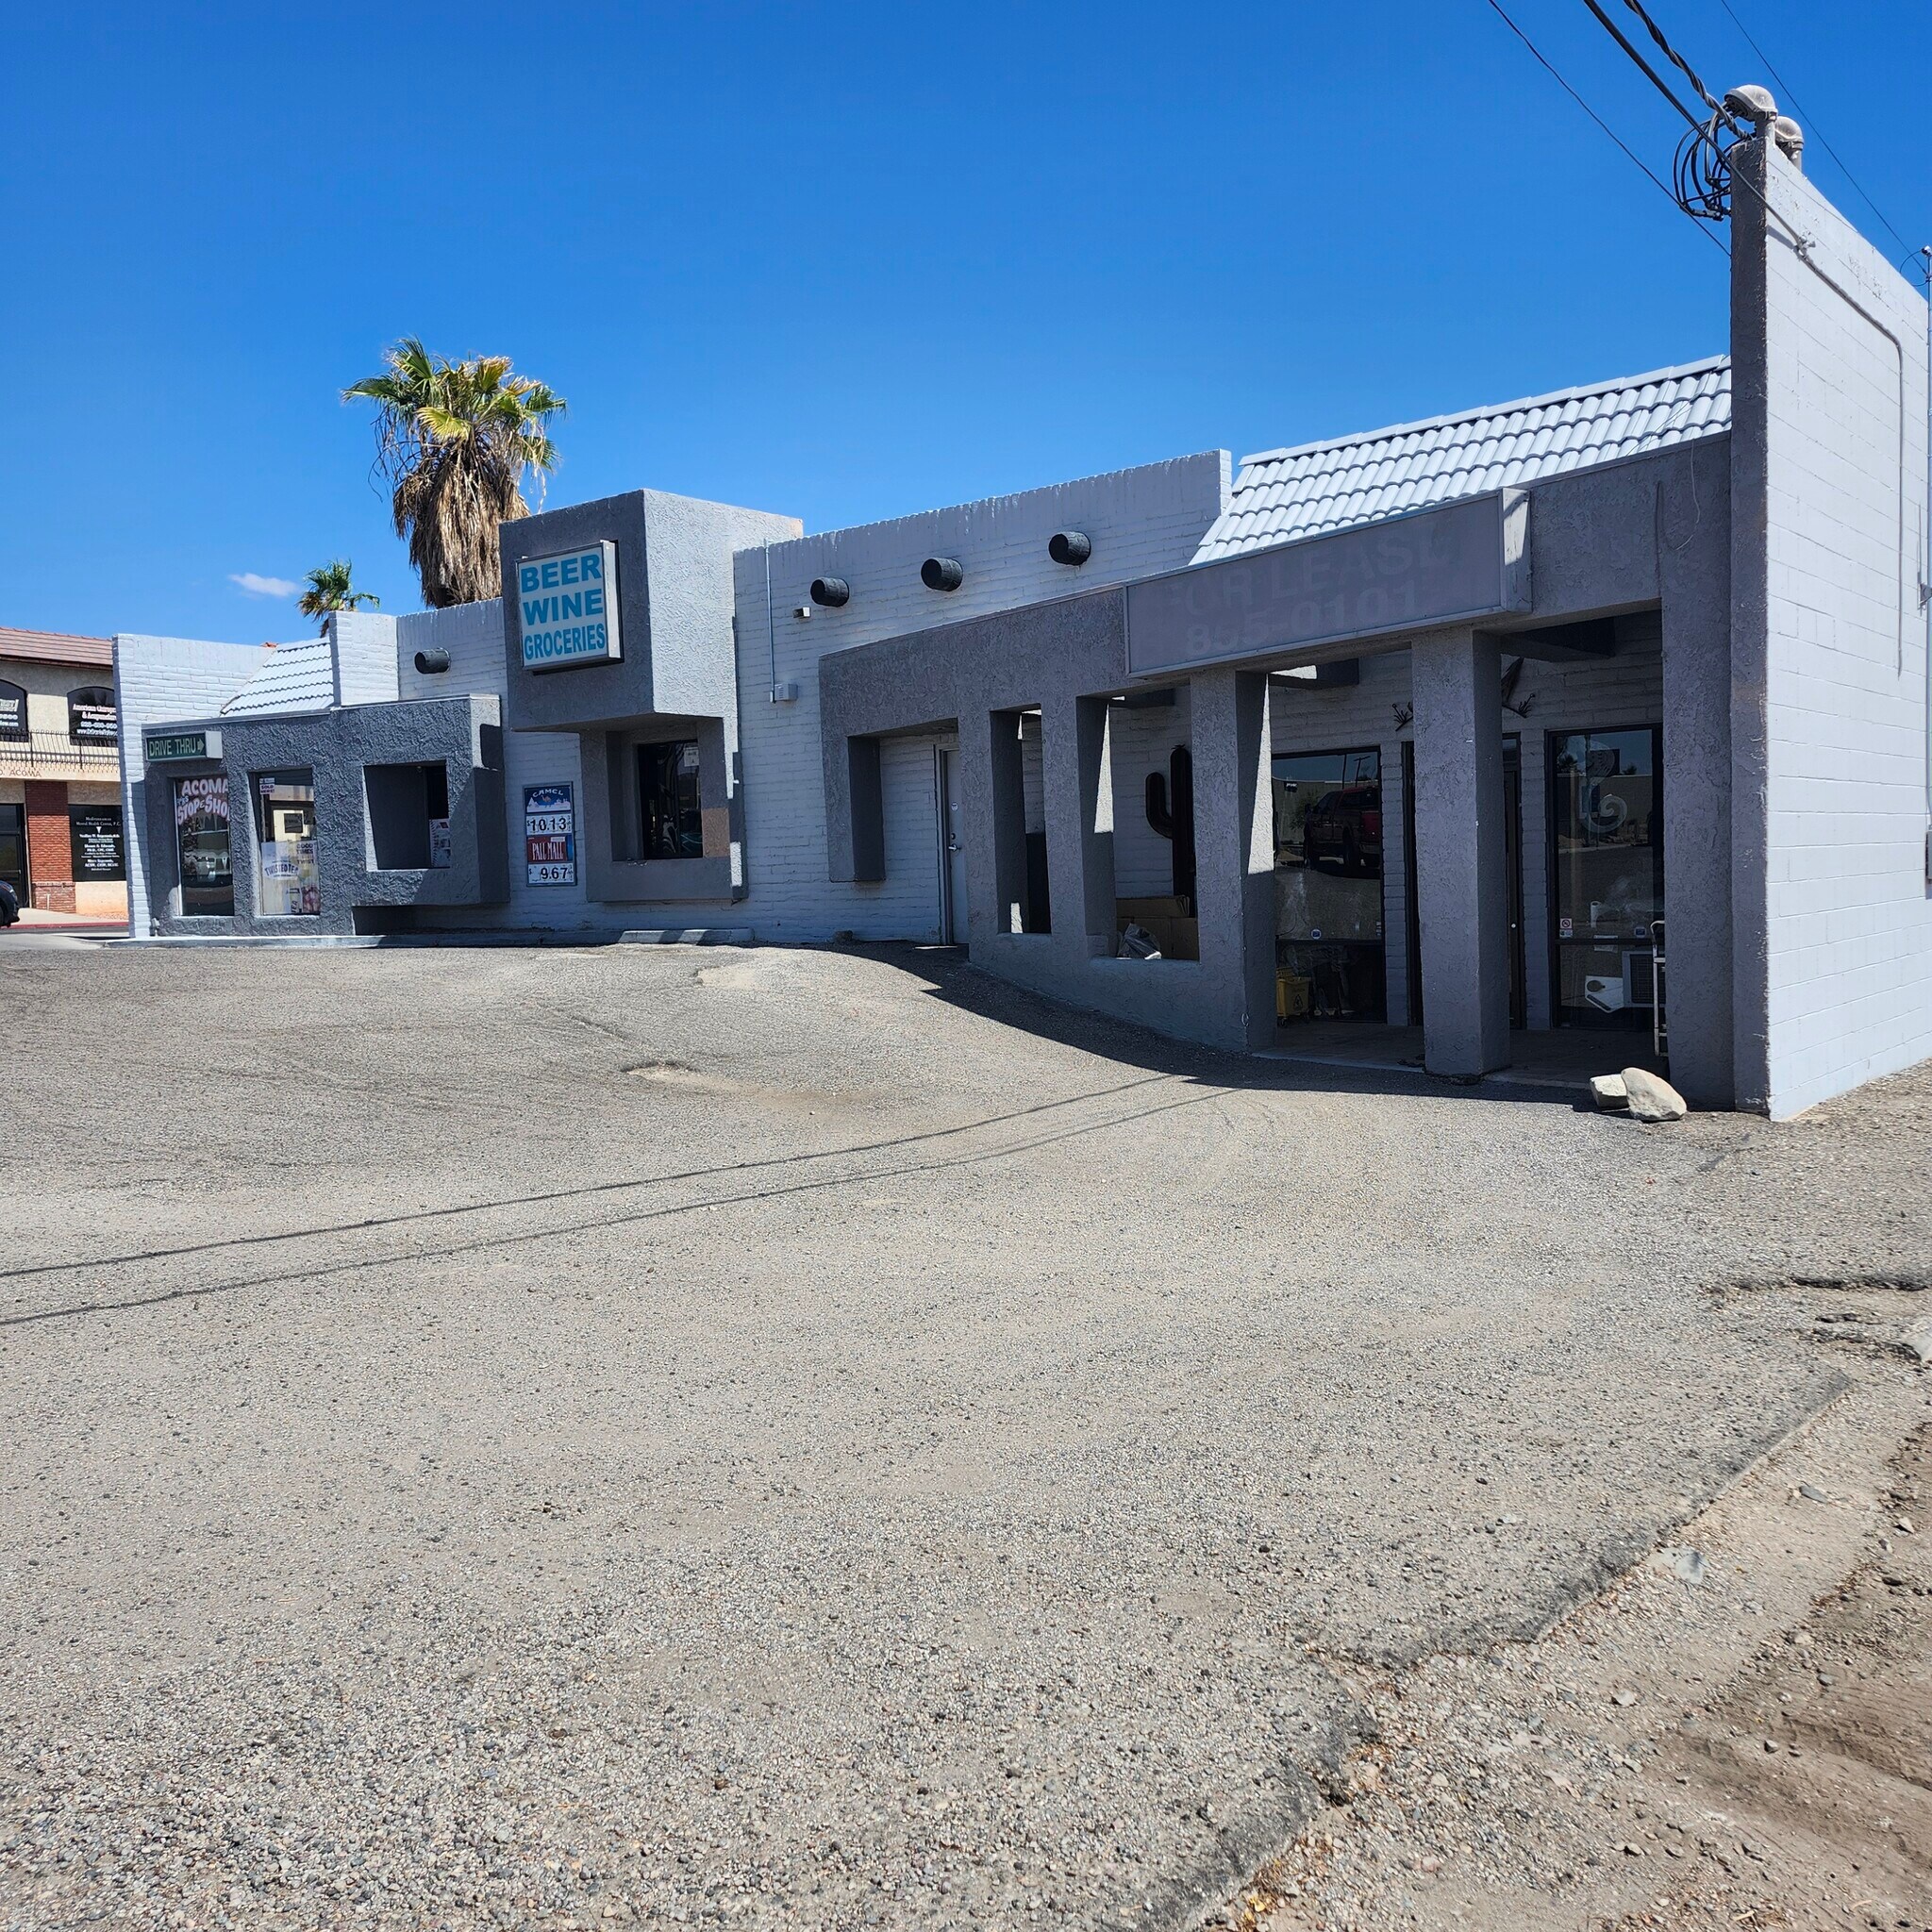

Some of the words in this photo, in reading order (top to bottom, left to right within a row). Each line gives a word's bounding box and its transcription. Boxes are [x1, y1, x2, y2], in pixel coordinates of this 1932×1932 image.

[521, 554, 602, 593] BEER
[523, 588, 604, 626] WINE
[524, 623, 606, 660] GROCERIES
[149, 740, 173, 757] DRIVE
[175, 737, 196, 754] THRU
[8, 769, 42, 777] ACOMA
[181, 777, 229, 796] ACOMA
[532, 788, 564, 798] CAMEL
[177, 798, 200, 825] STOP
[532, 841, 547, 861] PALL
[547, 841, 564, 860] MALL
[264, 864, 288, 876] TWISTED
[541, 867, 568, 880] 9.67
